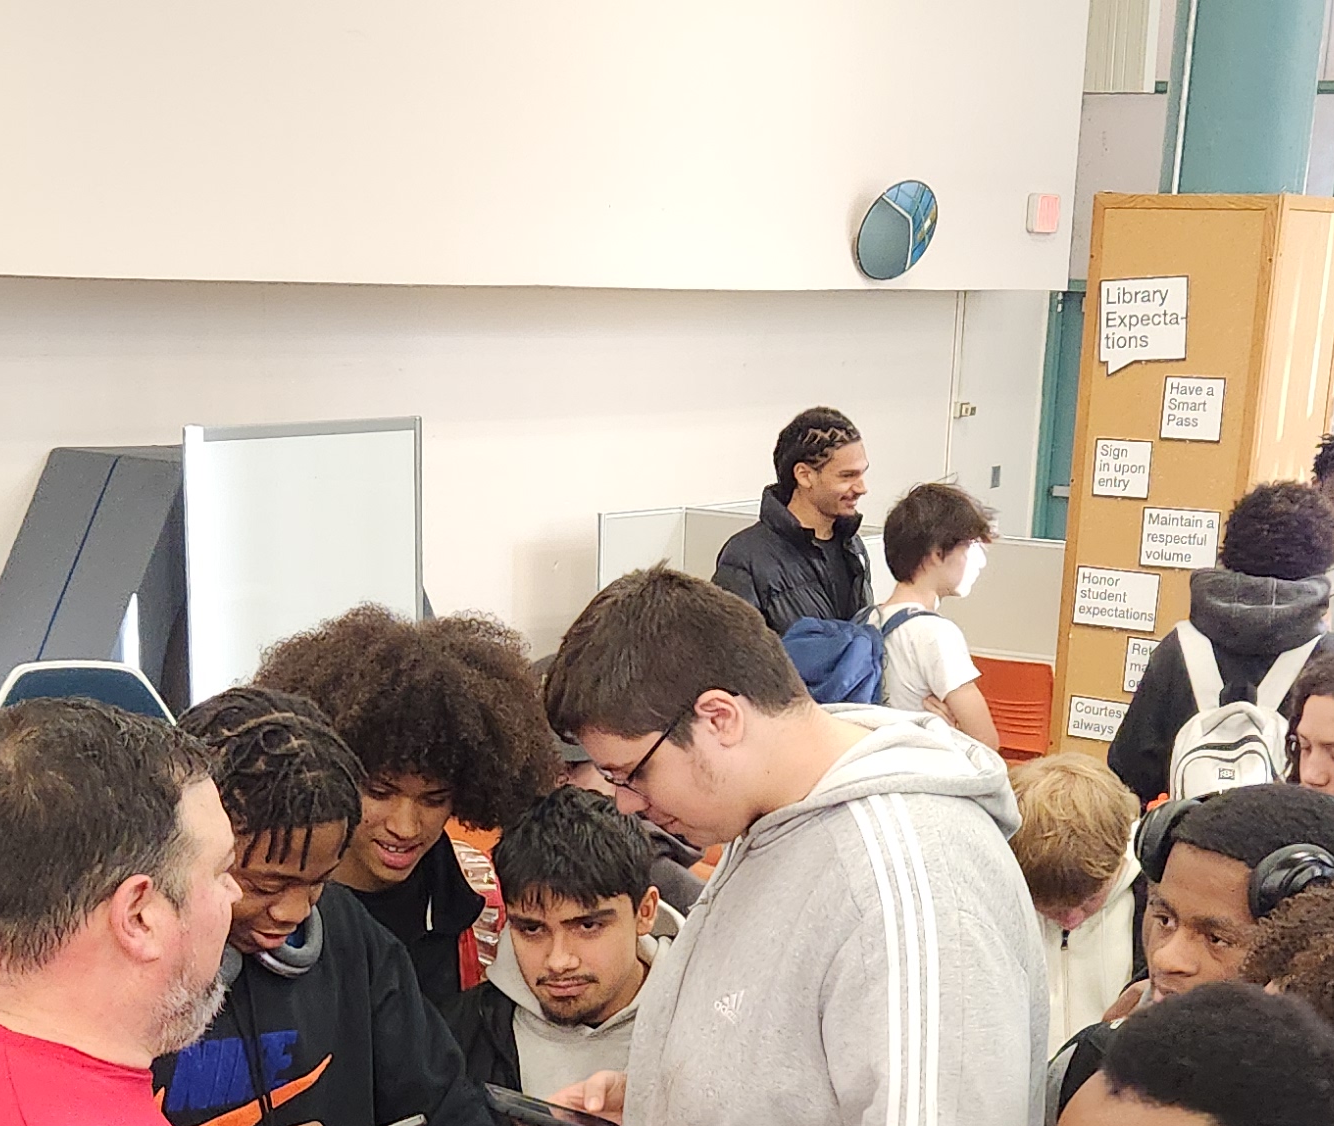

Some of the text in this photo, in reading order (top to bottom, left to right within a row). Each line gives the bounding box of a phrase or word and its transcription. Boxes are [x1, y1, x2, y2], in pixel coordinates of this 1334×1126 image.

[1105, 286, 1169, 307] Library
[1105, 309, 1187, 331] Expecta-
[1104, 332, 1149, 350] tions
[1169, 381, 1215, 397] Have a
[1167, 397, 1207, 412] Smart
[1166, 413, 1199, 428] Pass
[1100, 444, 1128, 460] Sign
[1098, 460, 1146, 475] in upon
[1098, 476, 1130, 491] entry
[1147, 512, 1215, 529] Maintain a
[1146, 531, 1207, 547] respectful
[1145, 548, 1192, 563] volume
[1081, 571, 1120, 587] Honor
[1080, 588, 1127, 603] student
[1078, 604, 1154, 622] expectations
[1072, 720, 1114, 735] always
